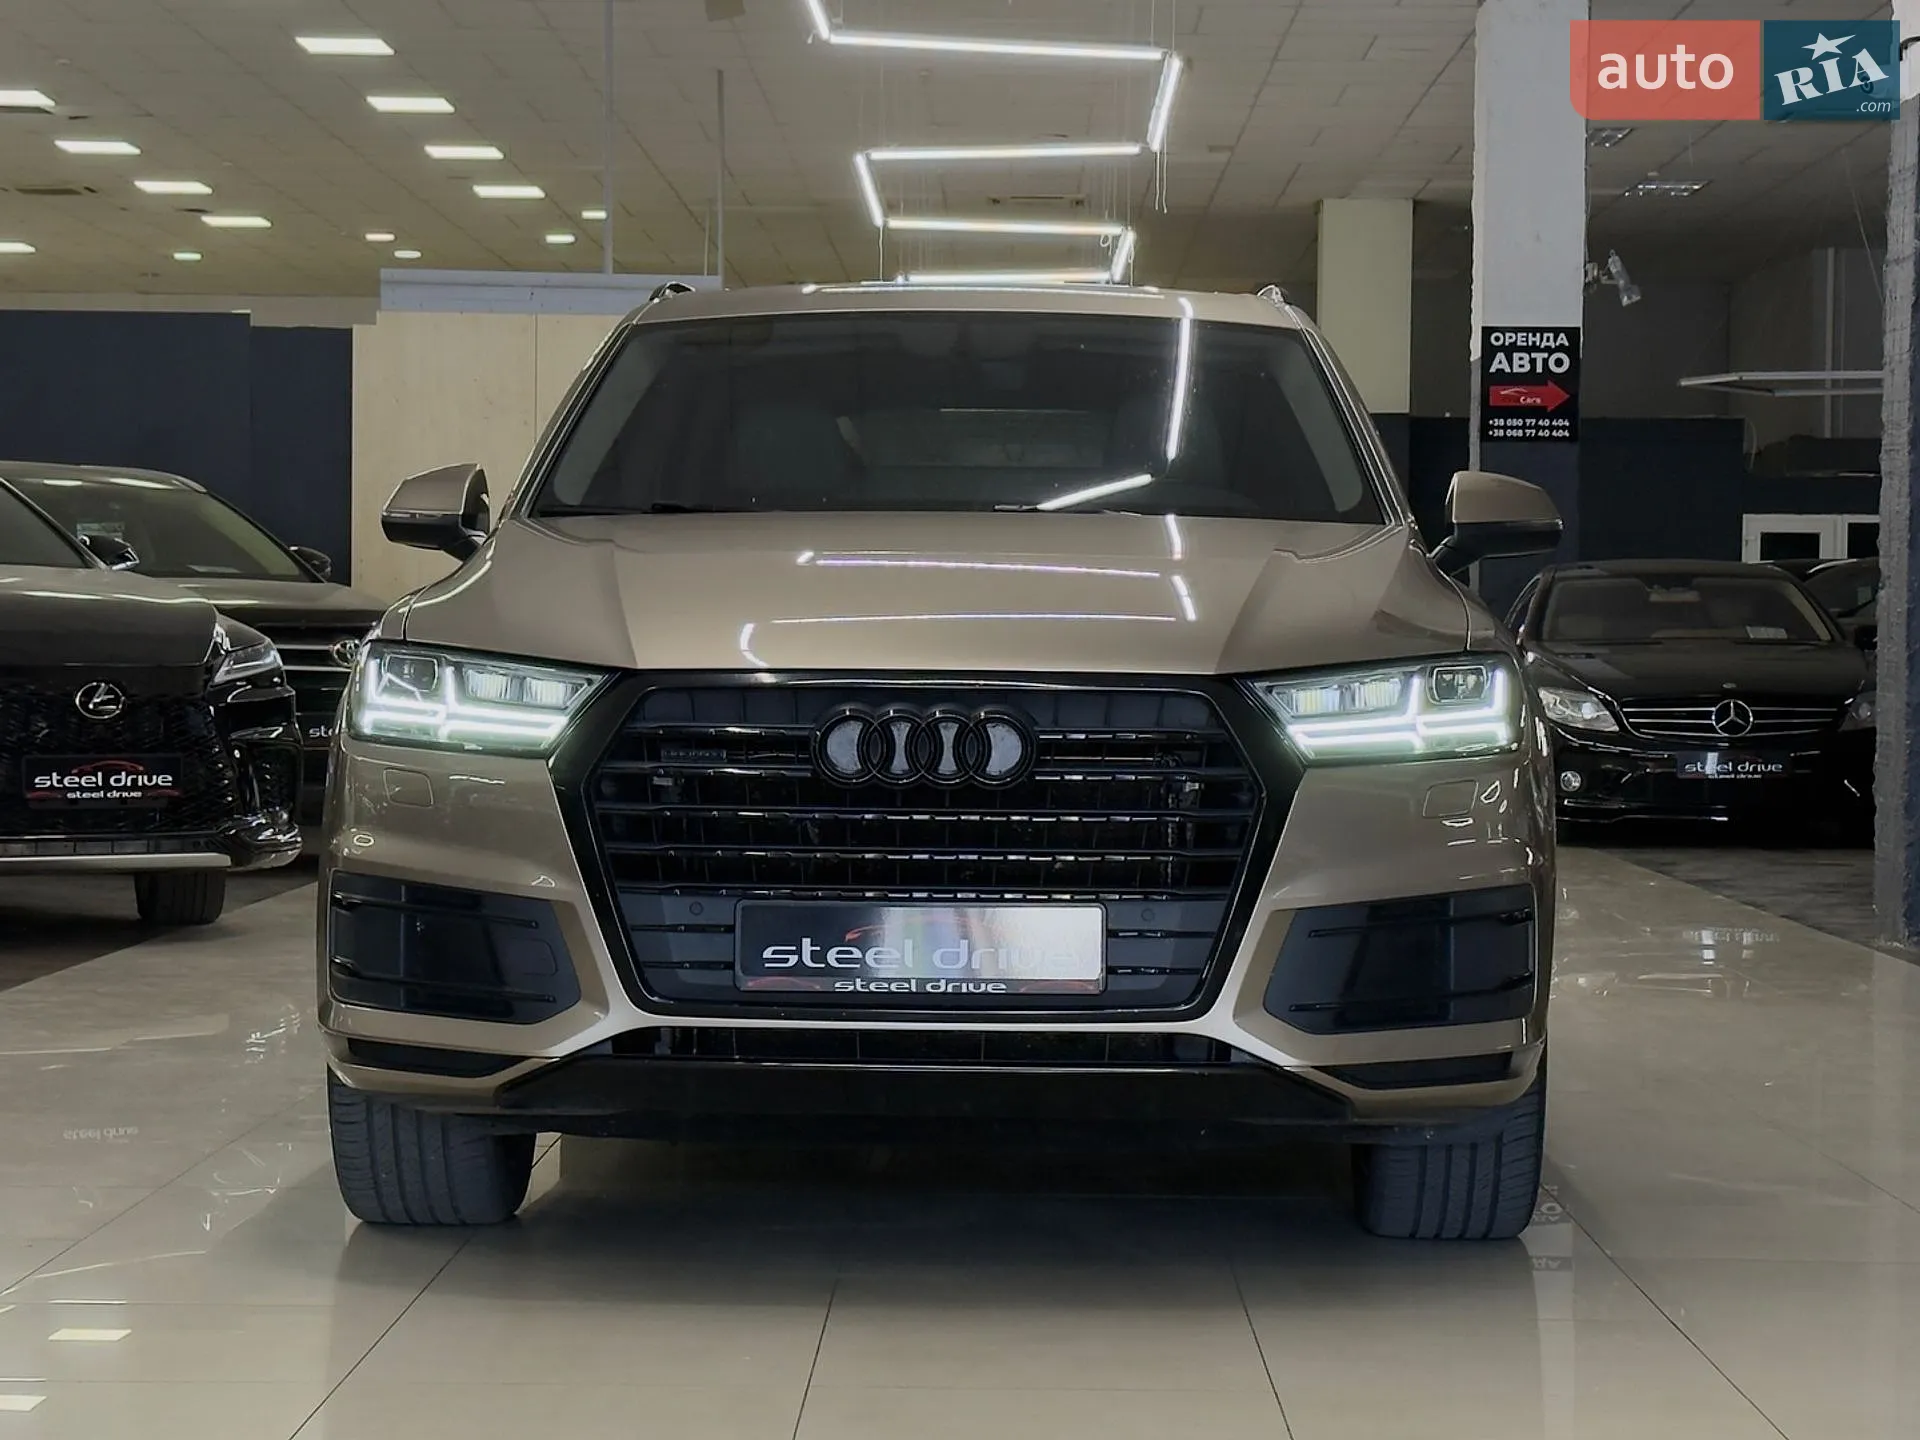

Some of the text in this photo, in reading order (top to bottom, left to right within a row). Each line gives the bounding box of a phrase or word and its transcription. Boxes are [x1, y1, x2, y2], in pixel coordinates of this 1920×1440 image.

[1490, 332, 1569, 348] ОРЕНДА
[1489, 352, 1571, 374] АВТО
[1737, 761, 1783, 772] drive
[34, 771, 173, 787] steel drive
[66, 790, 142, 798] steel drive
[762, 937, 913, 968] steel
[834, 978, 1007, 993] steel drive
